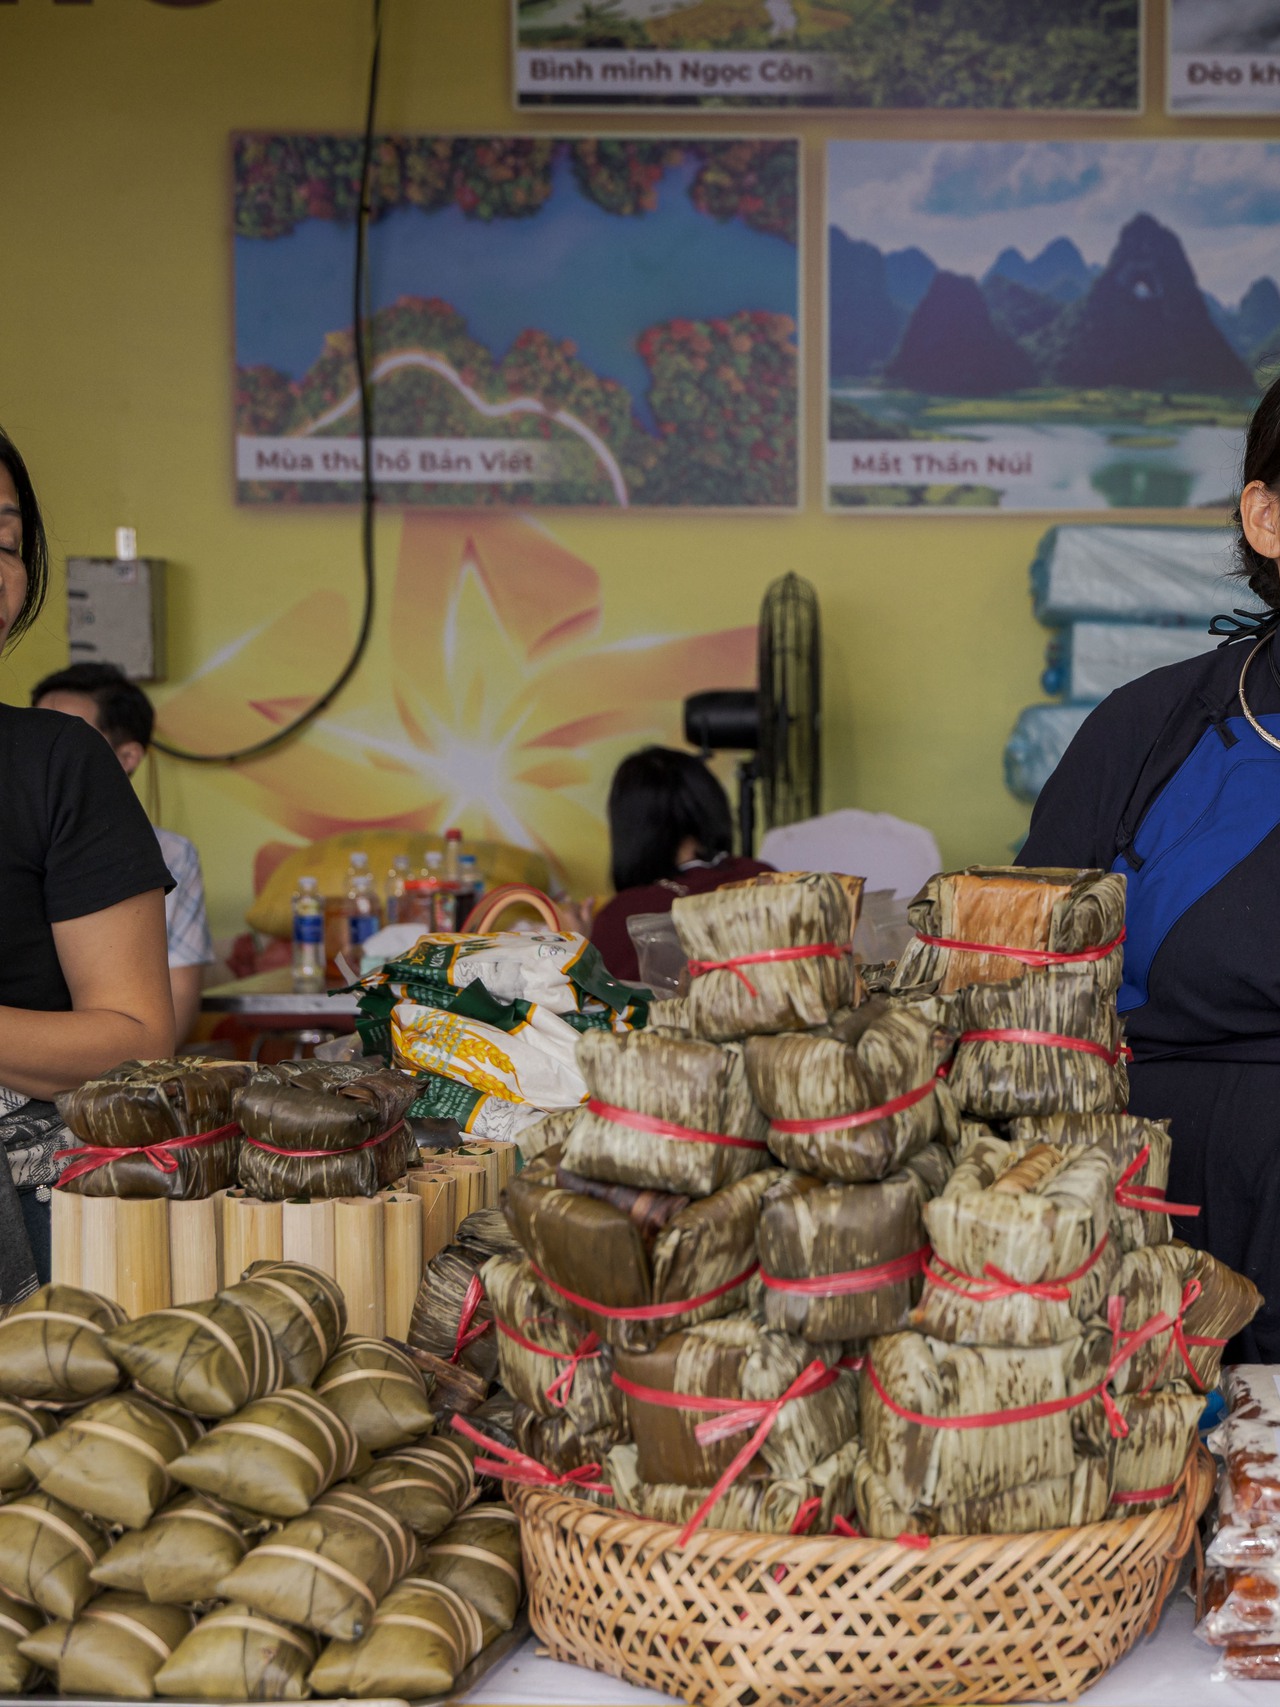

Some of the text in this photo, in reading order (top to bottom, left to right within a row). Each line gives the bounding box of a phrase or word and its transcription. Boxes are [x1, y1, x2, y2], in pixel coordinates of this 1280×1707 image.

[529, 58, 813, 87] Bình minh Ngọc Côn
[1187, 61, 1242, 86] Đèo
[255, 449, 314, 472] Mùa
[987, 452, 1033, 476] Núi
